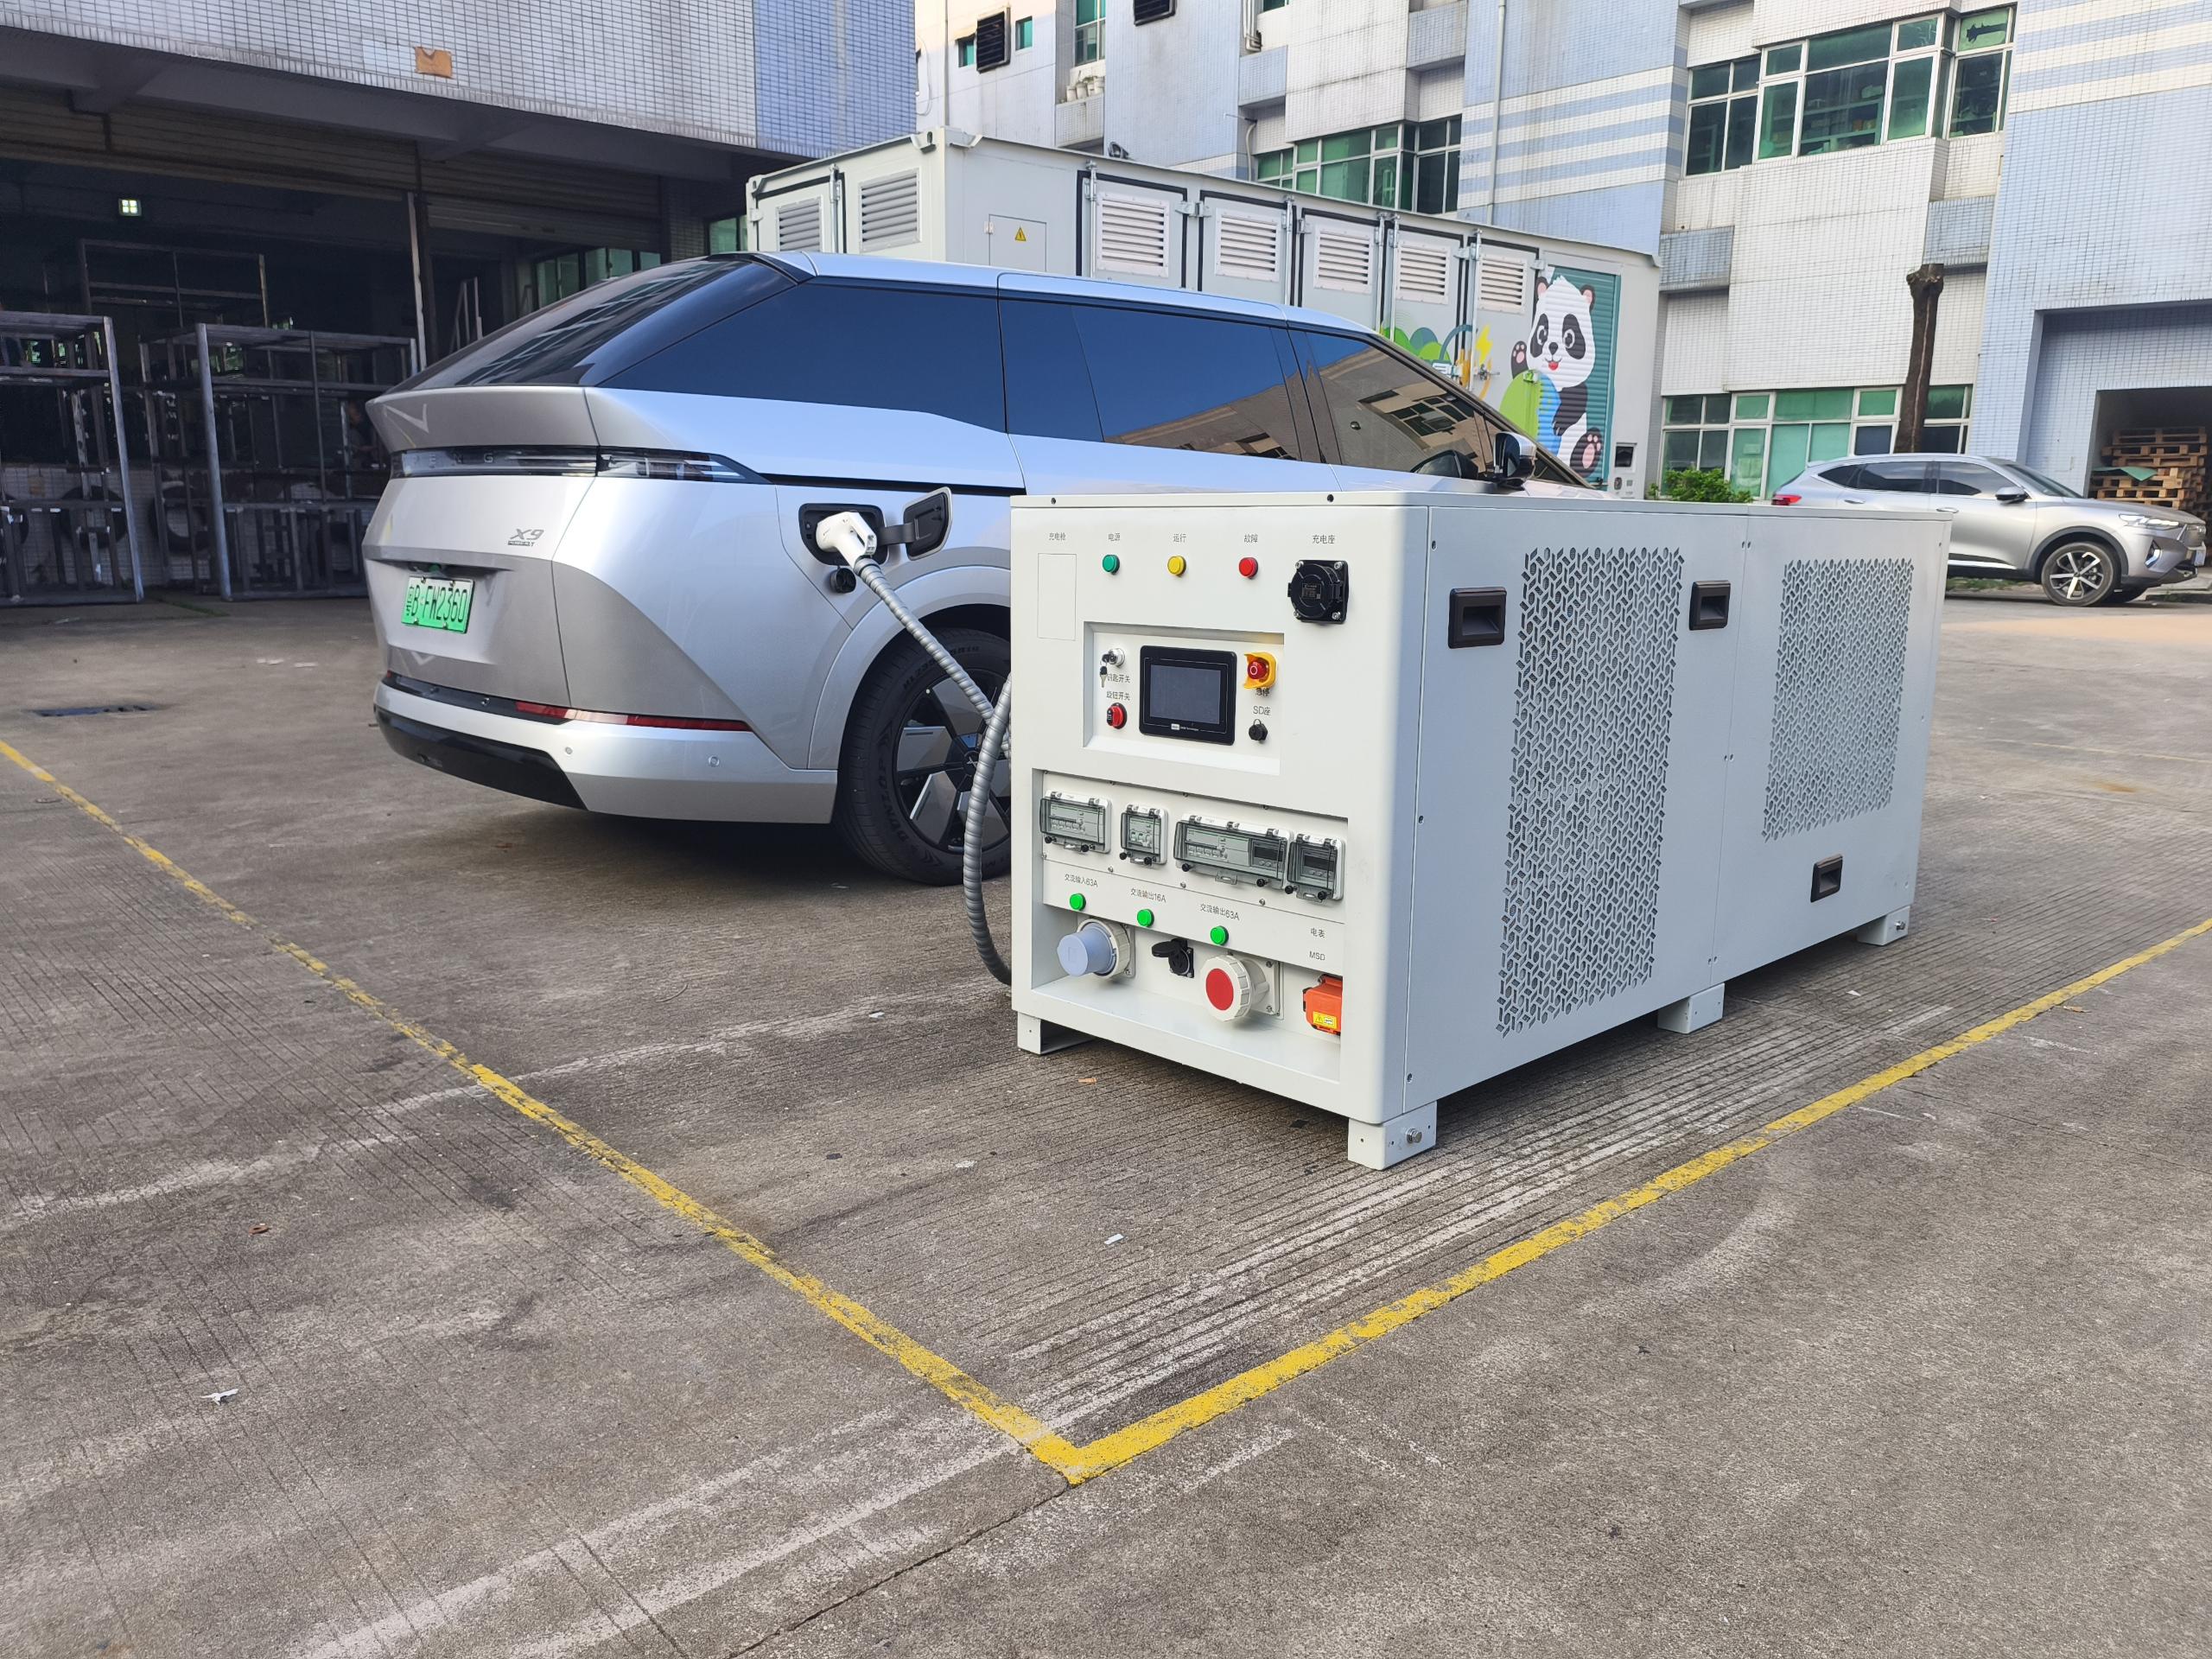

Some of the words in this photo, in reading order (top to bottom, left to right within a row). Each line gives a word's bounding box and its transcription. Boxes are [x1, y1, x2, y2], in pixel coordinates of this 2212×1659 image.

[510, 528, 544, 540] X9
[1048, 531, 1066, 541] 充电枪
[1108, 532, 1121, 542] 电源
[1173, 533, 1187, 543] 运行
[1243, 534, 1259, 543] 故障
[1313, 534, 1336, 544] 充电座
[1064, 874, 1098, 888] 交流输入63A
[1130, 887, 1166, 903] 交流输出16A
[1199, 903, 1240, 921] 交流输出63A
[1310, 927, 1325, 938] 电表
[1309, 950, 1325, 961] MSD
